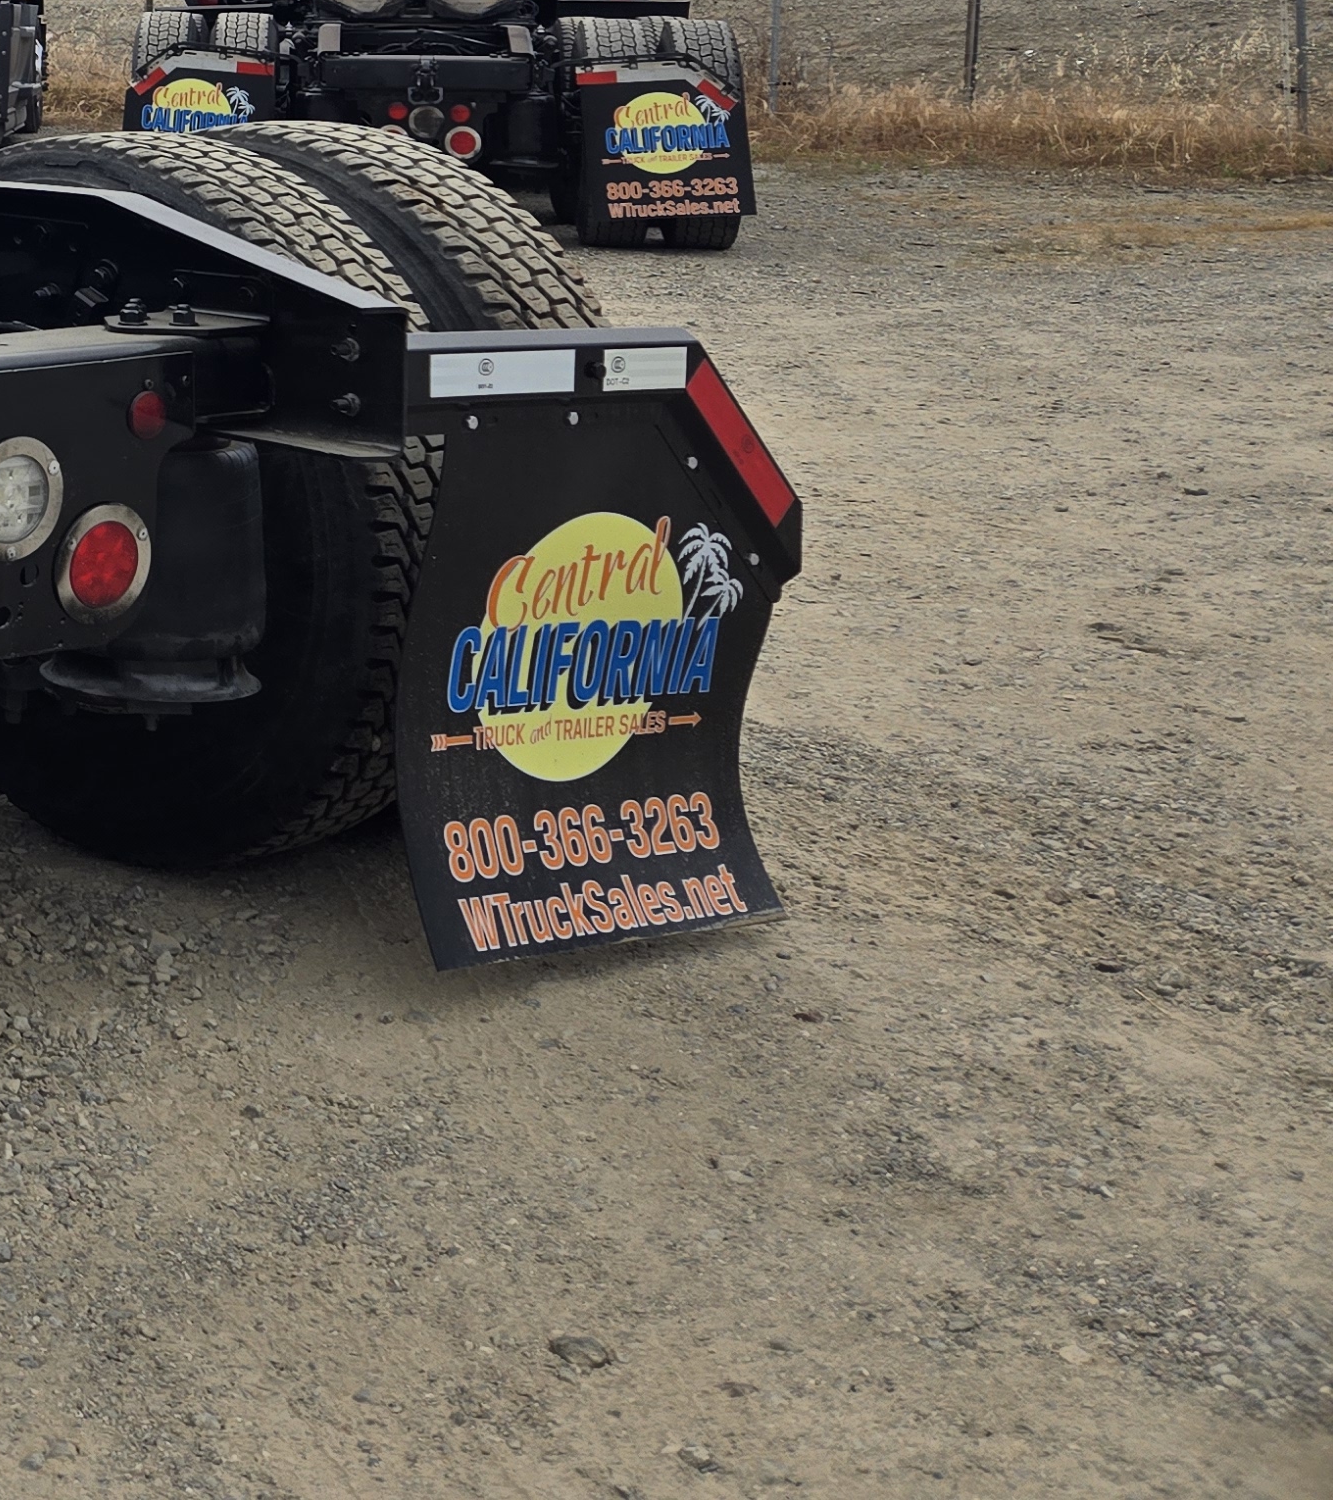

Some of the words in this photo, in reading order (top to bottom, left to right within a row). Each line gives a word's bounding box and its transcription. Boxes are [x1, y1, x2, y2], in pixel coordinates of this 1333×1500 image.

[152, 82, 223, 108] Central
[614, 92, 691, 129] Central
[605, 123, 731, 154] CALIFORNIA
[606, 177, 738, 200] 800-366-3263
[608, 198, 740, 218] WTruckSales.net
[486, 515, 671, 632] Central
[447, 617, 720, 713] CALIFORNIA
[472, 723, 525, 749] TRUCK
[530, 713, 552, 744] and
[554, 716, 614, 741] TRAILER
[618, 710, 666, 736] SALES
[444, 792, 720, 882] 800-366-3263
[457, 863, 748, 951] WTruckSales.net
